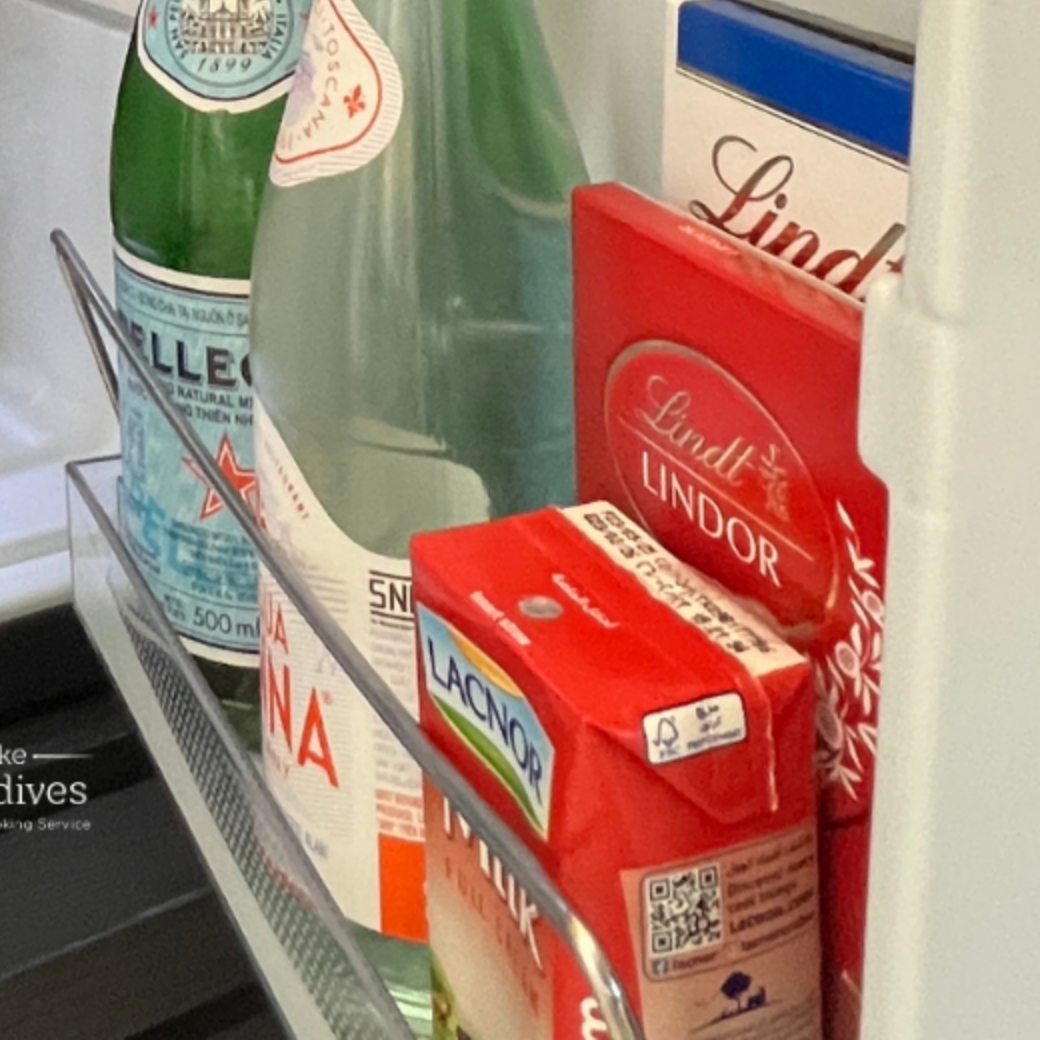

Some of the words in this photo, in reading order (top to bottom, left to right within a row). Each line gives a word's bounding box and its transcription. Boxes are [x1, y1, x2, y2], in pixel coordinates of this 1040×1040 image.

[688, 134, 906, 303] Lind
[177, 385, 235, 408] NATURAL
[635, 374, 760, 487] Lindt
[642, 450, 782, 588] LINDOR
[193, 606, 232, 635] 500
[264, 646, 340, 790] NA
[426, 635, 545, 806] LACNOR
